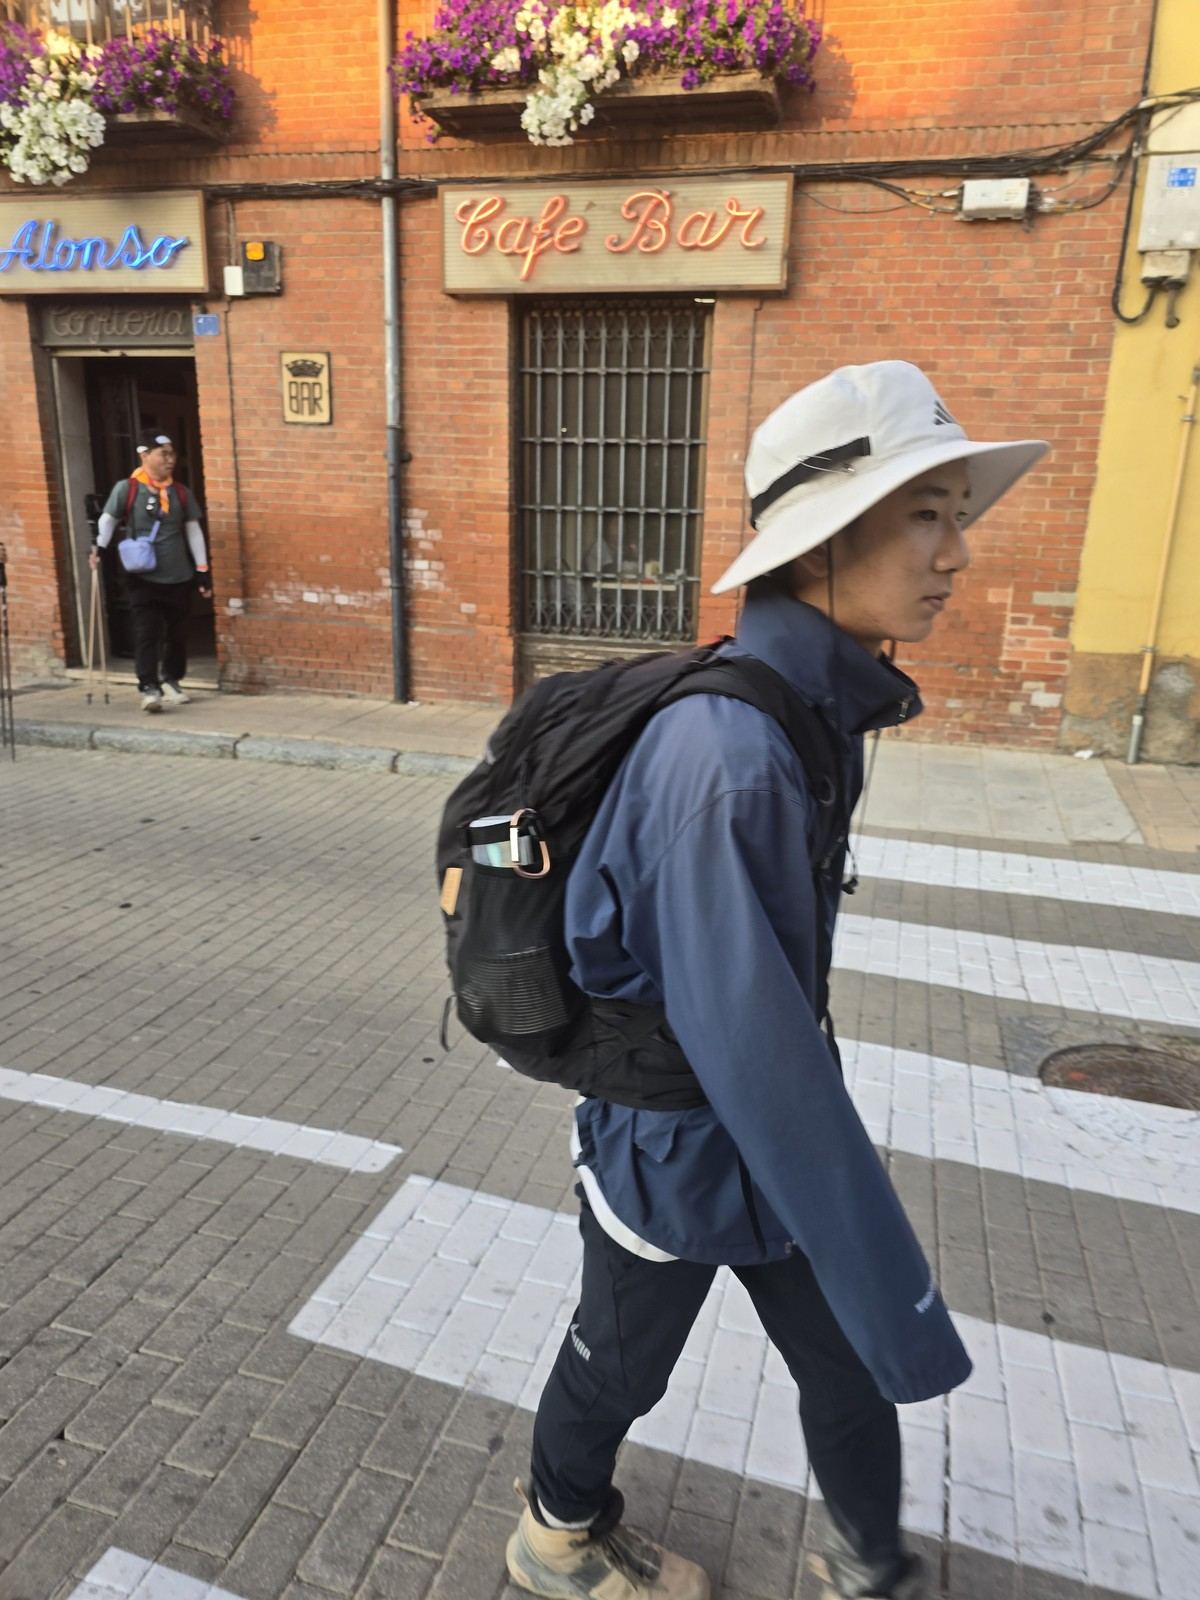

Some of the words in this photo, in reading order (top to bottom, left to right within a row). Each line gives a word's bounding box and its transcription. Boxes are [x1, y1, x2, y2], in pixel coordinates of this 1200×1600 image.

[0, 218, 189, 272] Alonso
[604, 190, 767, 252] Bar
[288, 381, 324, 416] BAR
